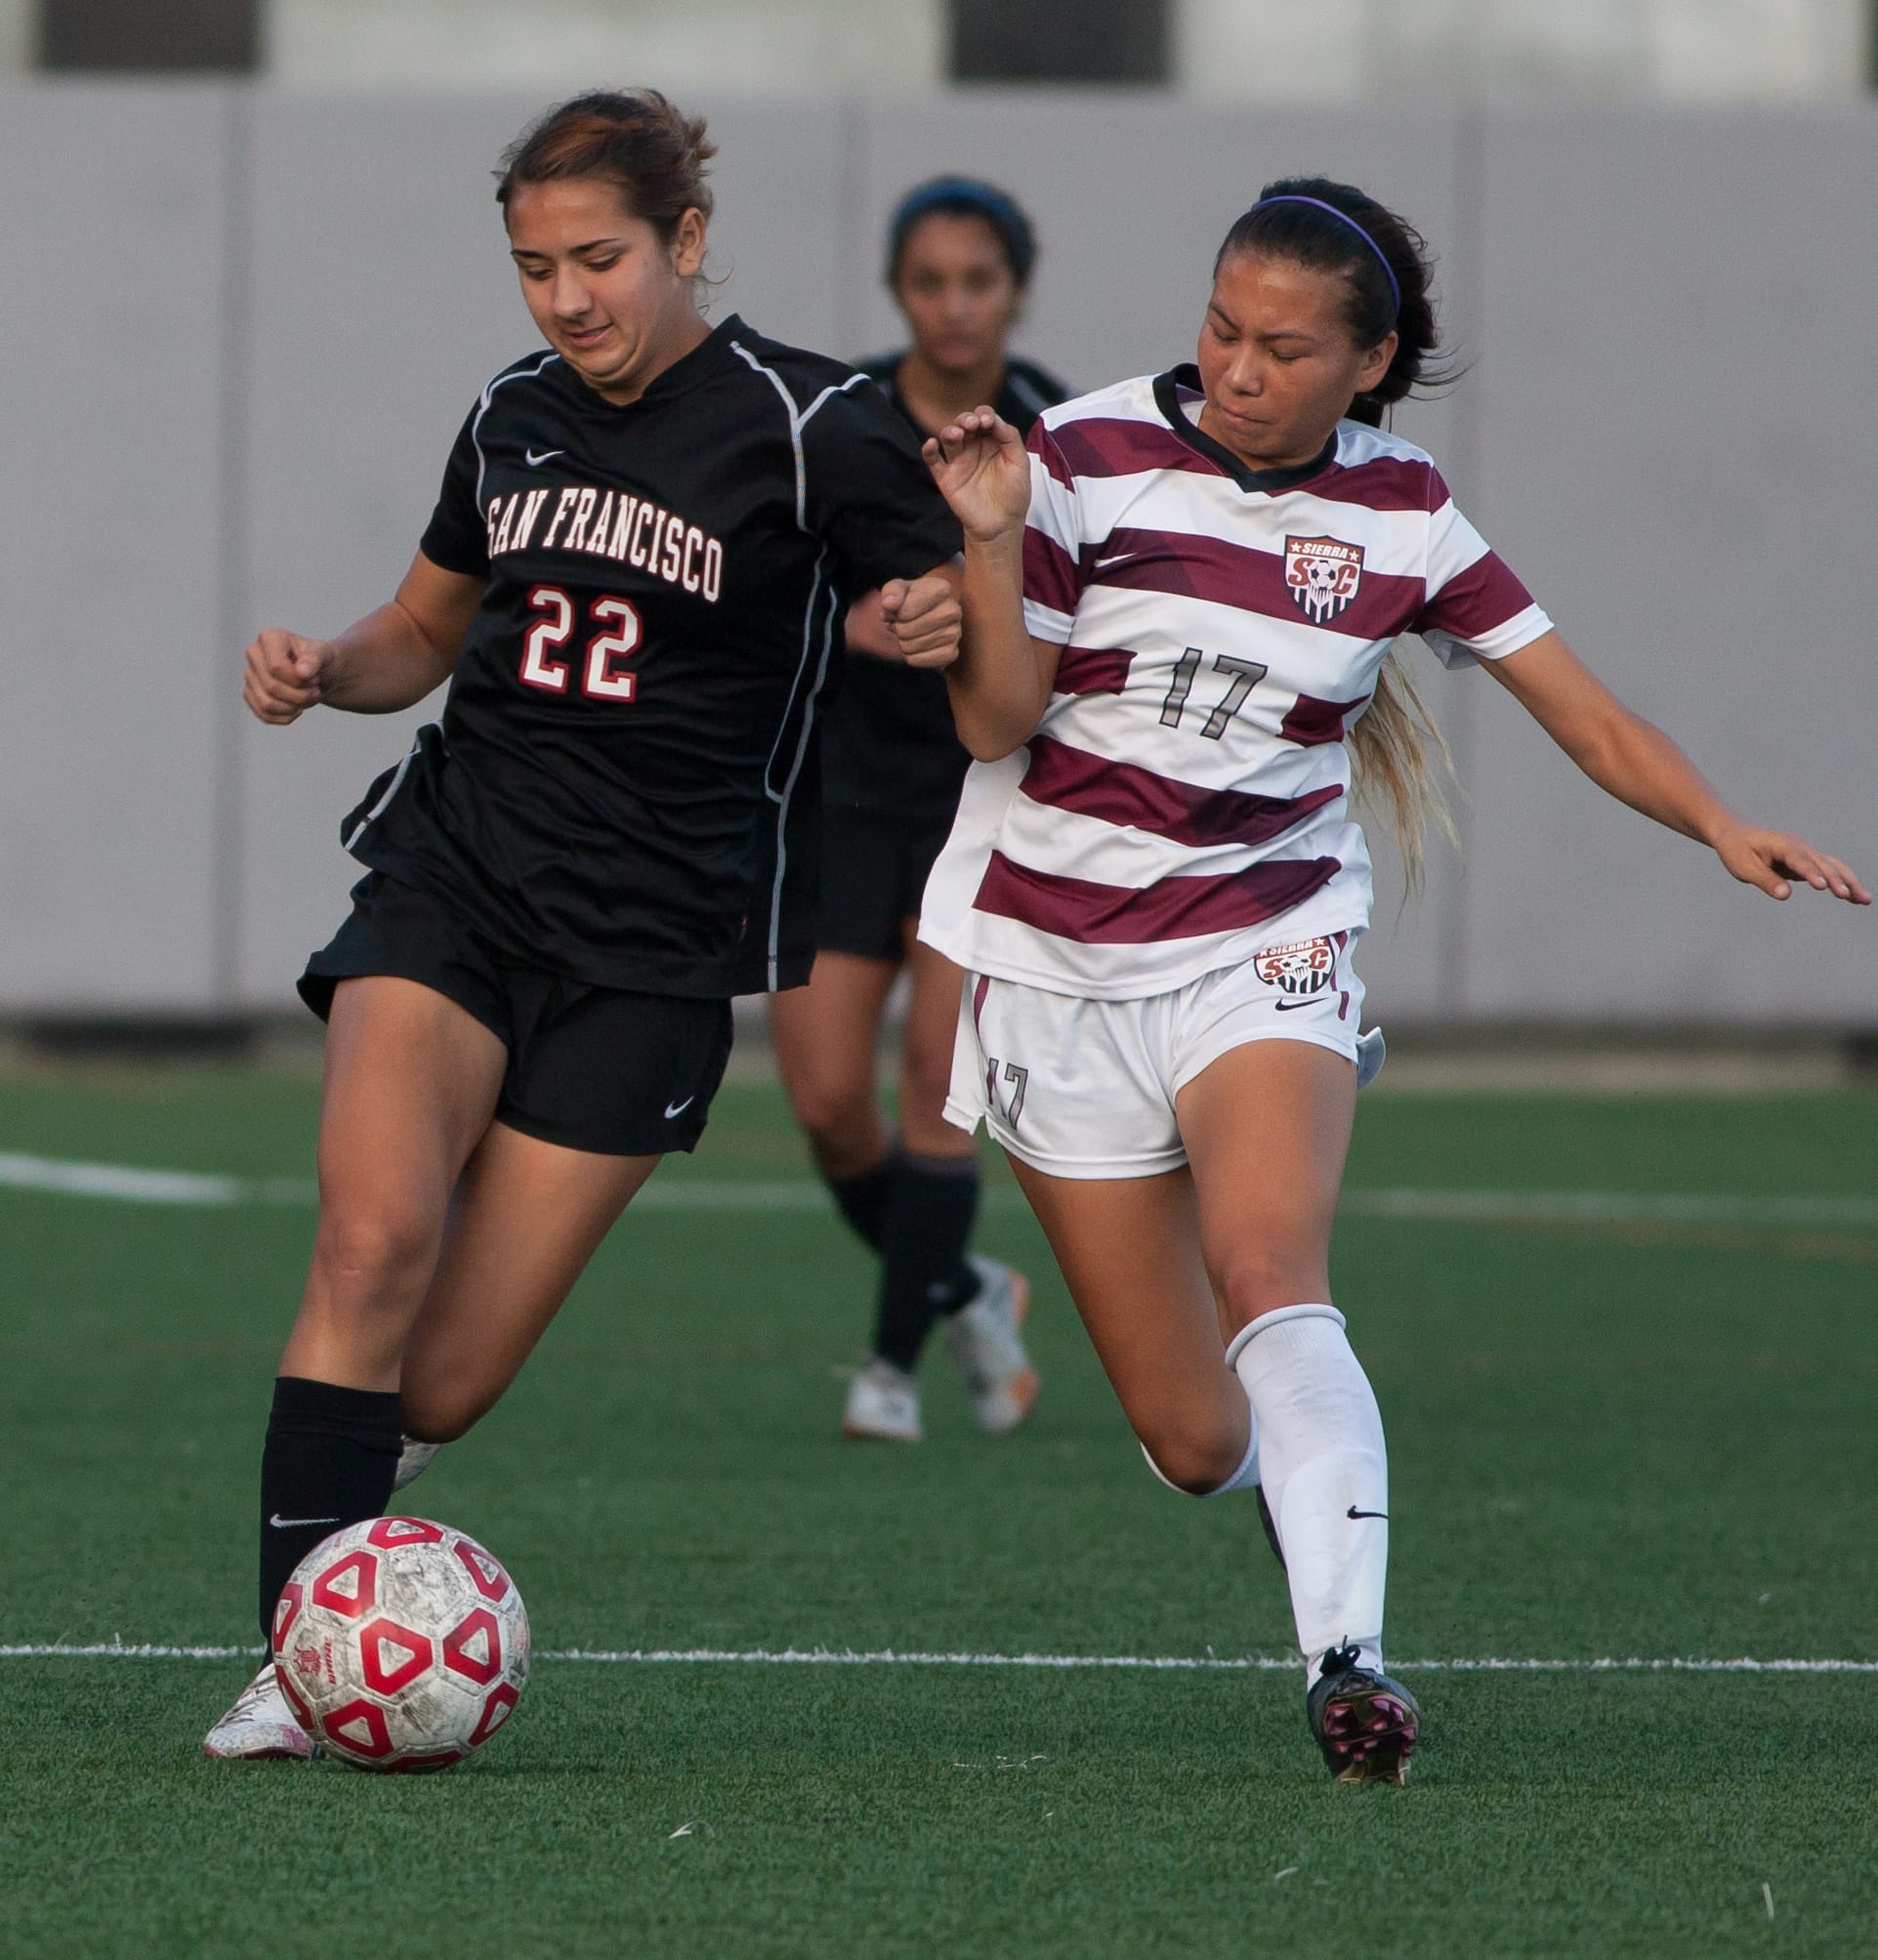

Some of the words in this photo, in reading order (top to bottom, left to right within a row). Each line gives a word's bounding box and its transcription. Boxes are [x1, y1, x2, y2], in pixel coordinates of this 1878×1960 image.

[487, 488, 549, 561] SAN
[541, 487, 724, 604] FRANCISCO
[1302, 542, 1349, 560] SIERRA
[519, 585, 644, 704] 22
[1158, 646, 1269, 741] 17
[988, 1057, 1028, 1131] 17
